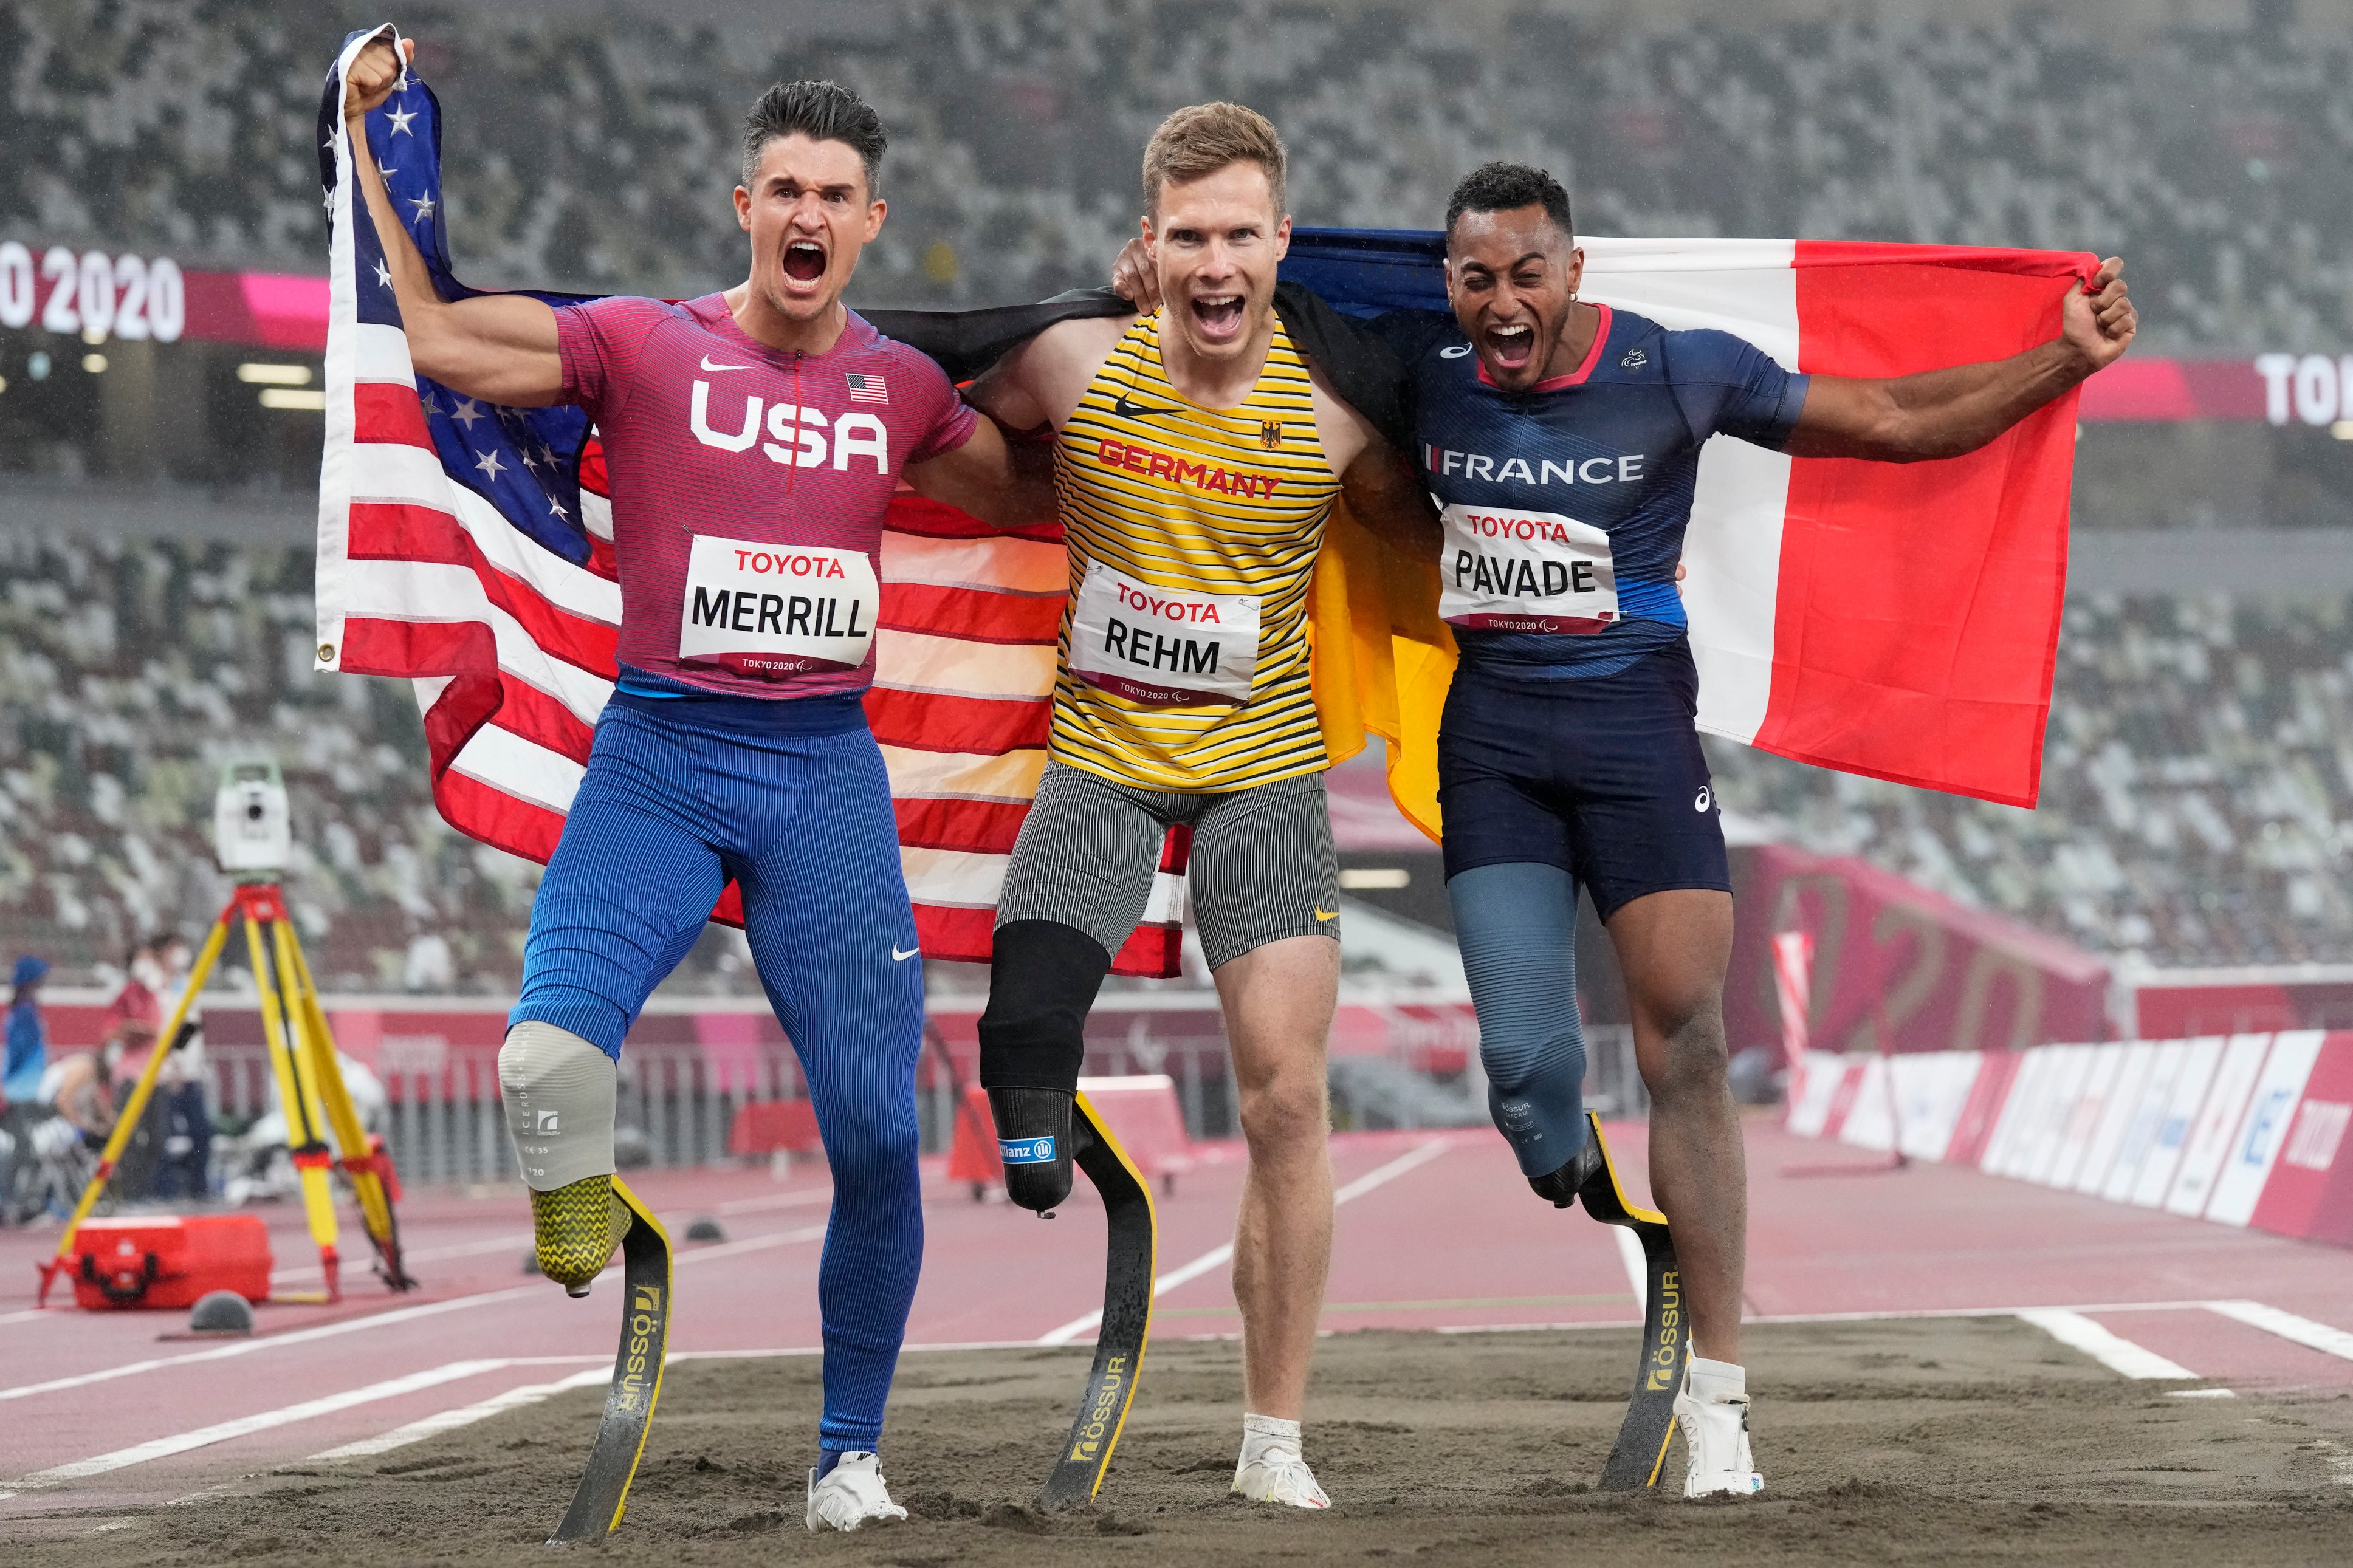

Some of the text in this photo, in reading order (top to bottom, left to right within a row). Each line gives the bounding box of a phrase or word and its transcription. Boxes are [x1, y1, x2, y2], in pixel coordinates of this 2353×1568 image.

[41, 245, 185, 344] 2020
[690, 379, 889, 475] USA
[1097, 437, 1283, 501] GERMANY
[1443, 448, 1645, 485] FRANCE
[1466, 514, 1570, 544] TOYOTA
[734, 549, 845, 579] TOYOTA
[1456, 549, 1596, 598] PAVADE
[691, 585, 868, 638] MERRILL
[1116, 581, 1221, 624] TOYOTA
[1488, 618, 1537, 630] TOKYO 2020
[743, 658, 794, 671] TOKYO 2020
[1104, 617, 1220, 674] REHM
[1120, 681, 1169, 700] TOKYO 2020
[1505, 1102, 1531, 1113] ÖSSUR
[1652, 1270, 1680, 1366] ÖSSUR
[617, 1313, 657, 1411] ÖSSUR
[1080, 1356, 1127, 1439] ÖSSUR
